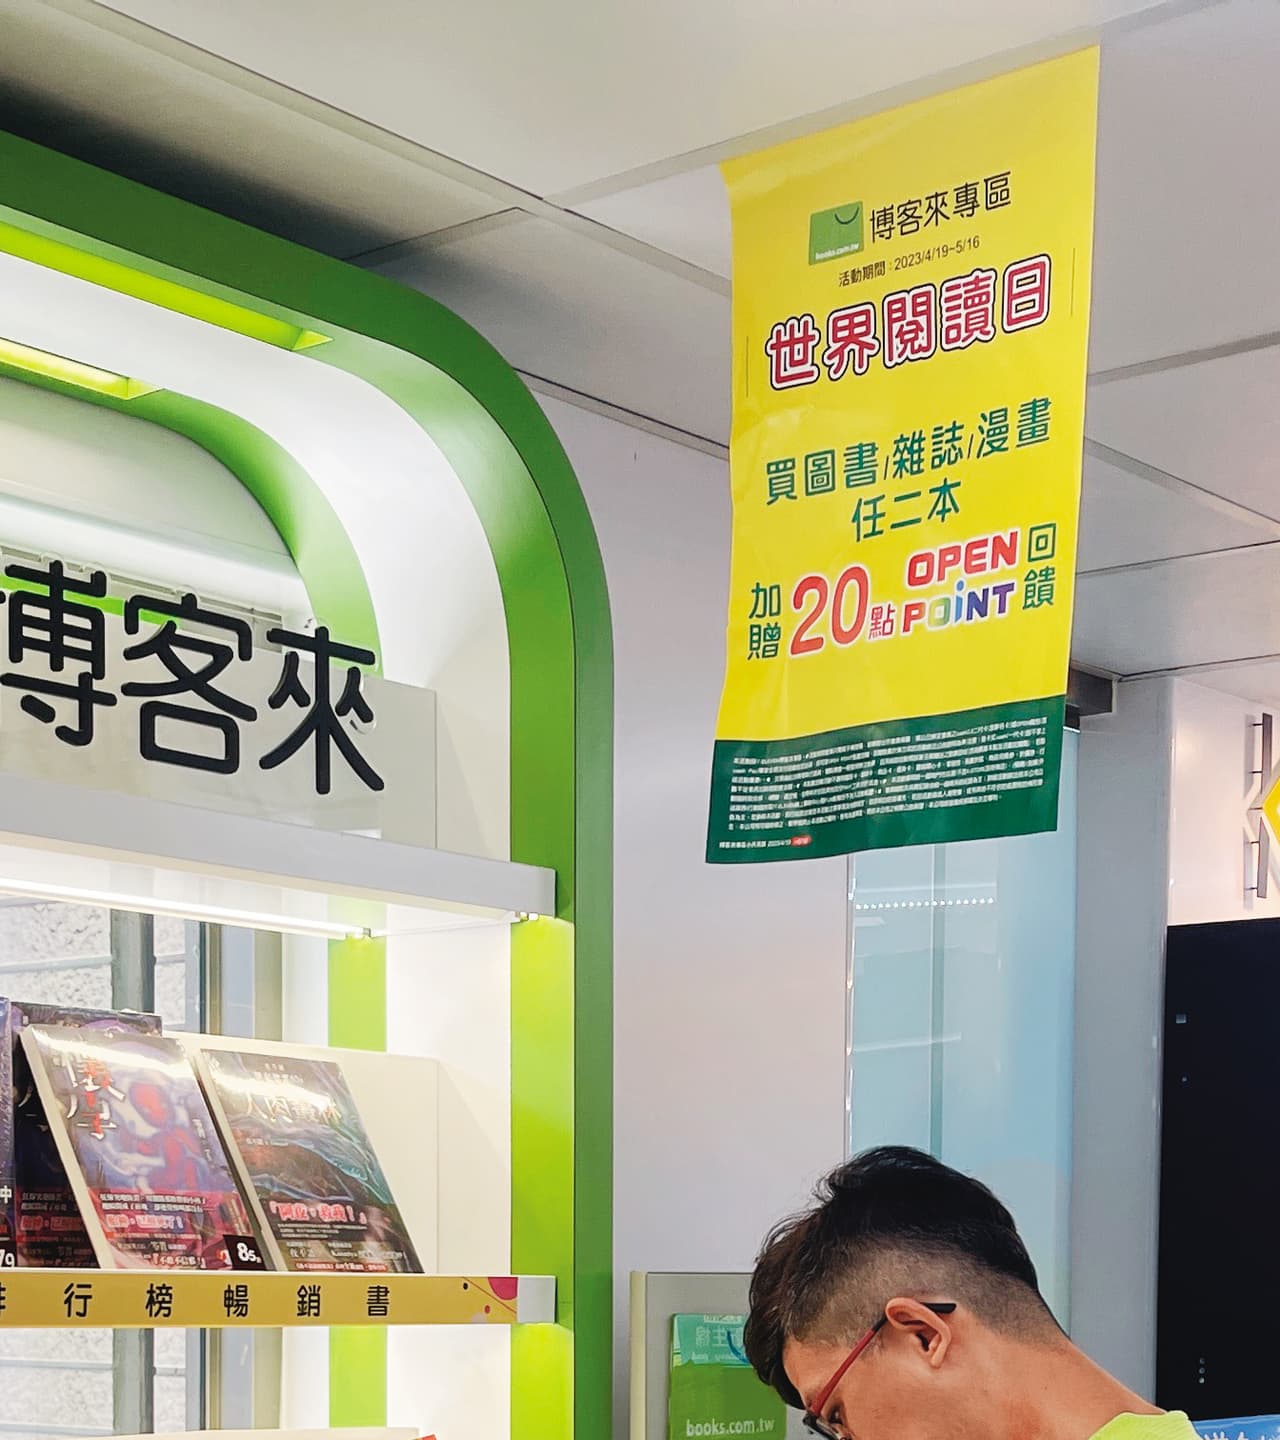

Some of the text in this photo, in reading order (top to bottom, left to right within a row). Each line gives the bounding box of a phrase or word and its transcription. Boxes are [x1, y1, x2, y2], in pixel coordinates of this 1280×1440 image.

[869, 171, 1011, 243] 博客來專區
[766, 253, 1051, 389] 世界閱讀日
[766, 397, 1051, 505] 買圖書/雜誌/漫畫
[851, 478, 961, 542] 任二本
[907, 531, 1019, 587] OPEN
[1022, 523, 1056, 611] 回饋
[747, 582, 781, 660] 加贈
[686, 1417, 775, 1438] books.com.tw
